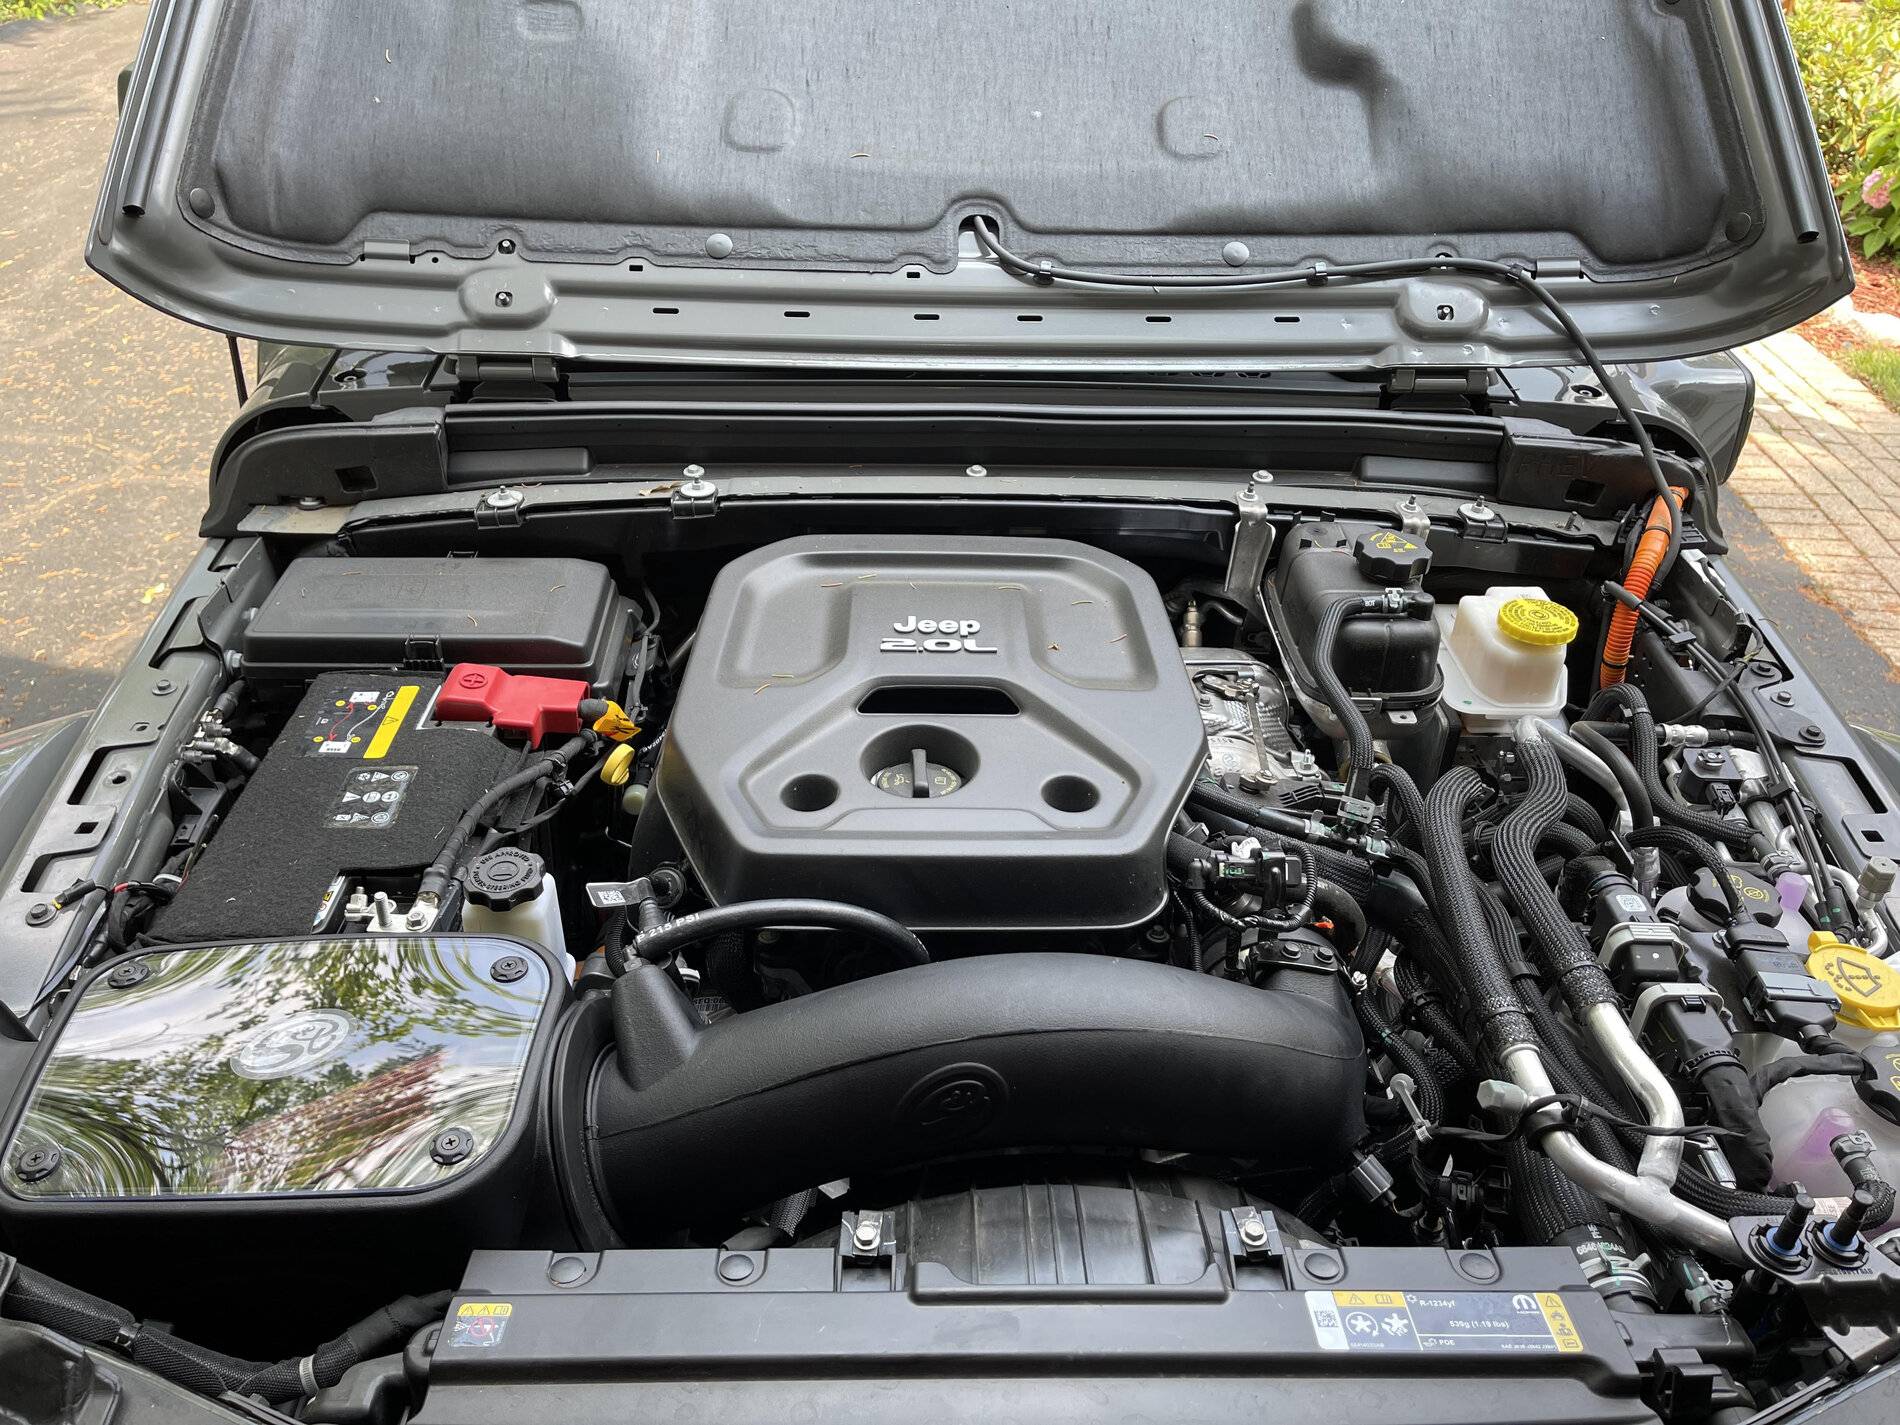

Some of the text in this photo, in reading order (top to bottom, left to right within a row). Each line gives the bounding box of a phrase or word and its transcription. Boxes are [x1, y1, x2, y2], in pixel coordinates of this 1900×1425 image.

[893, 615, 981, 638] Jeep
[880, 638, 998, 653] 2.0L
[649, 921, 672, 937] 215
[676, 913, 701, 926] PSI
